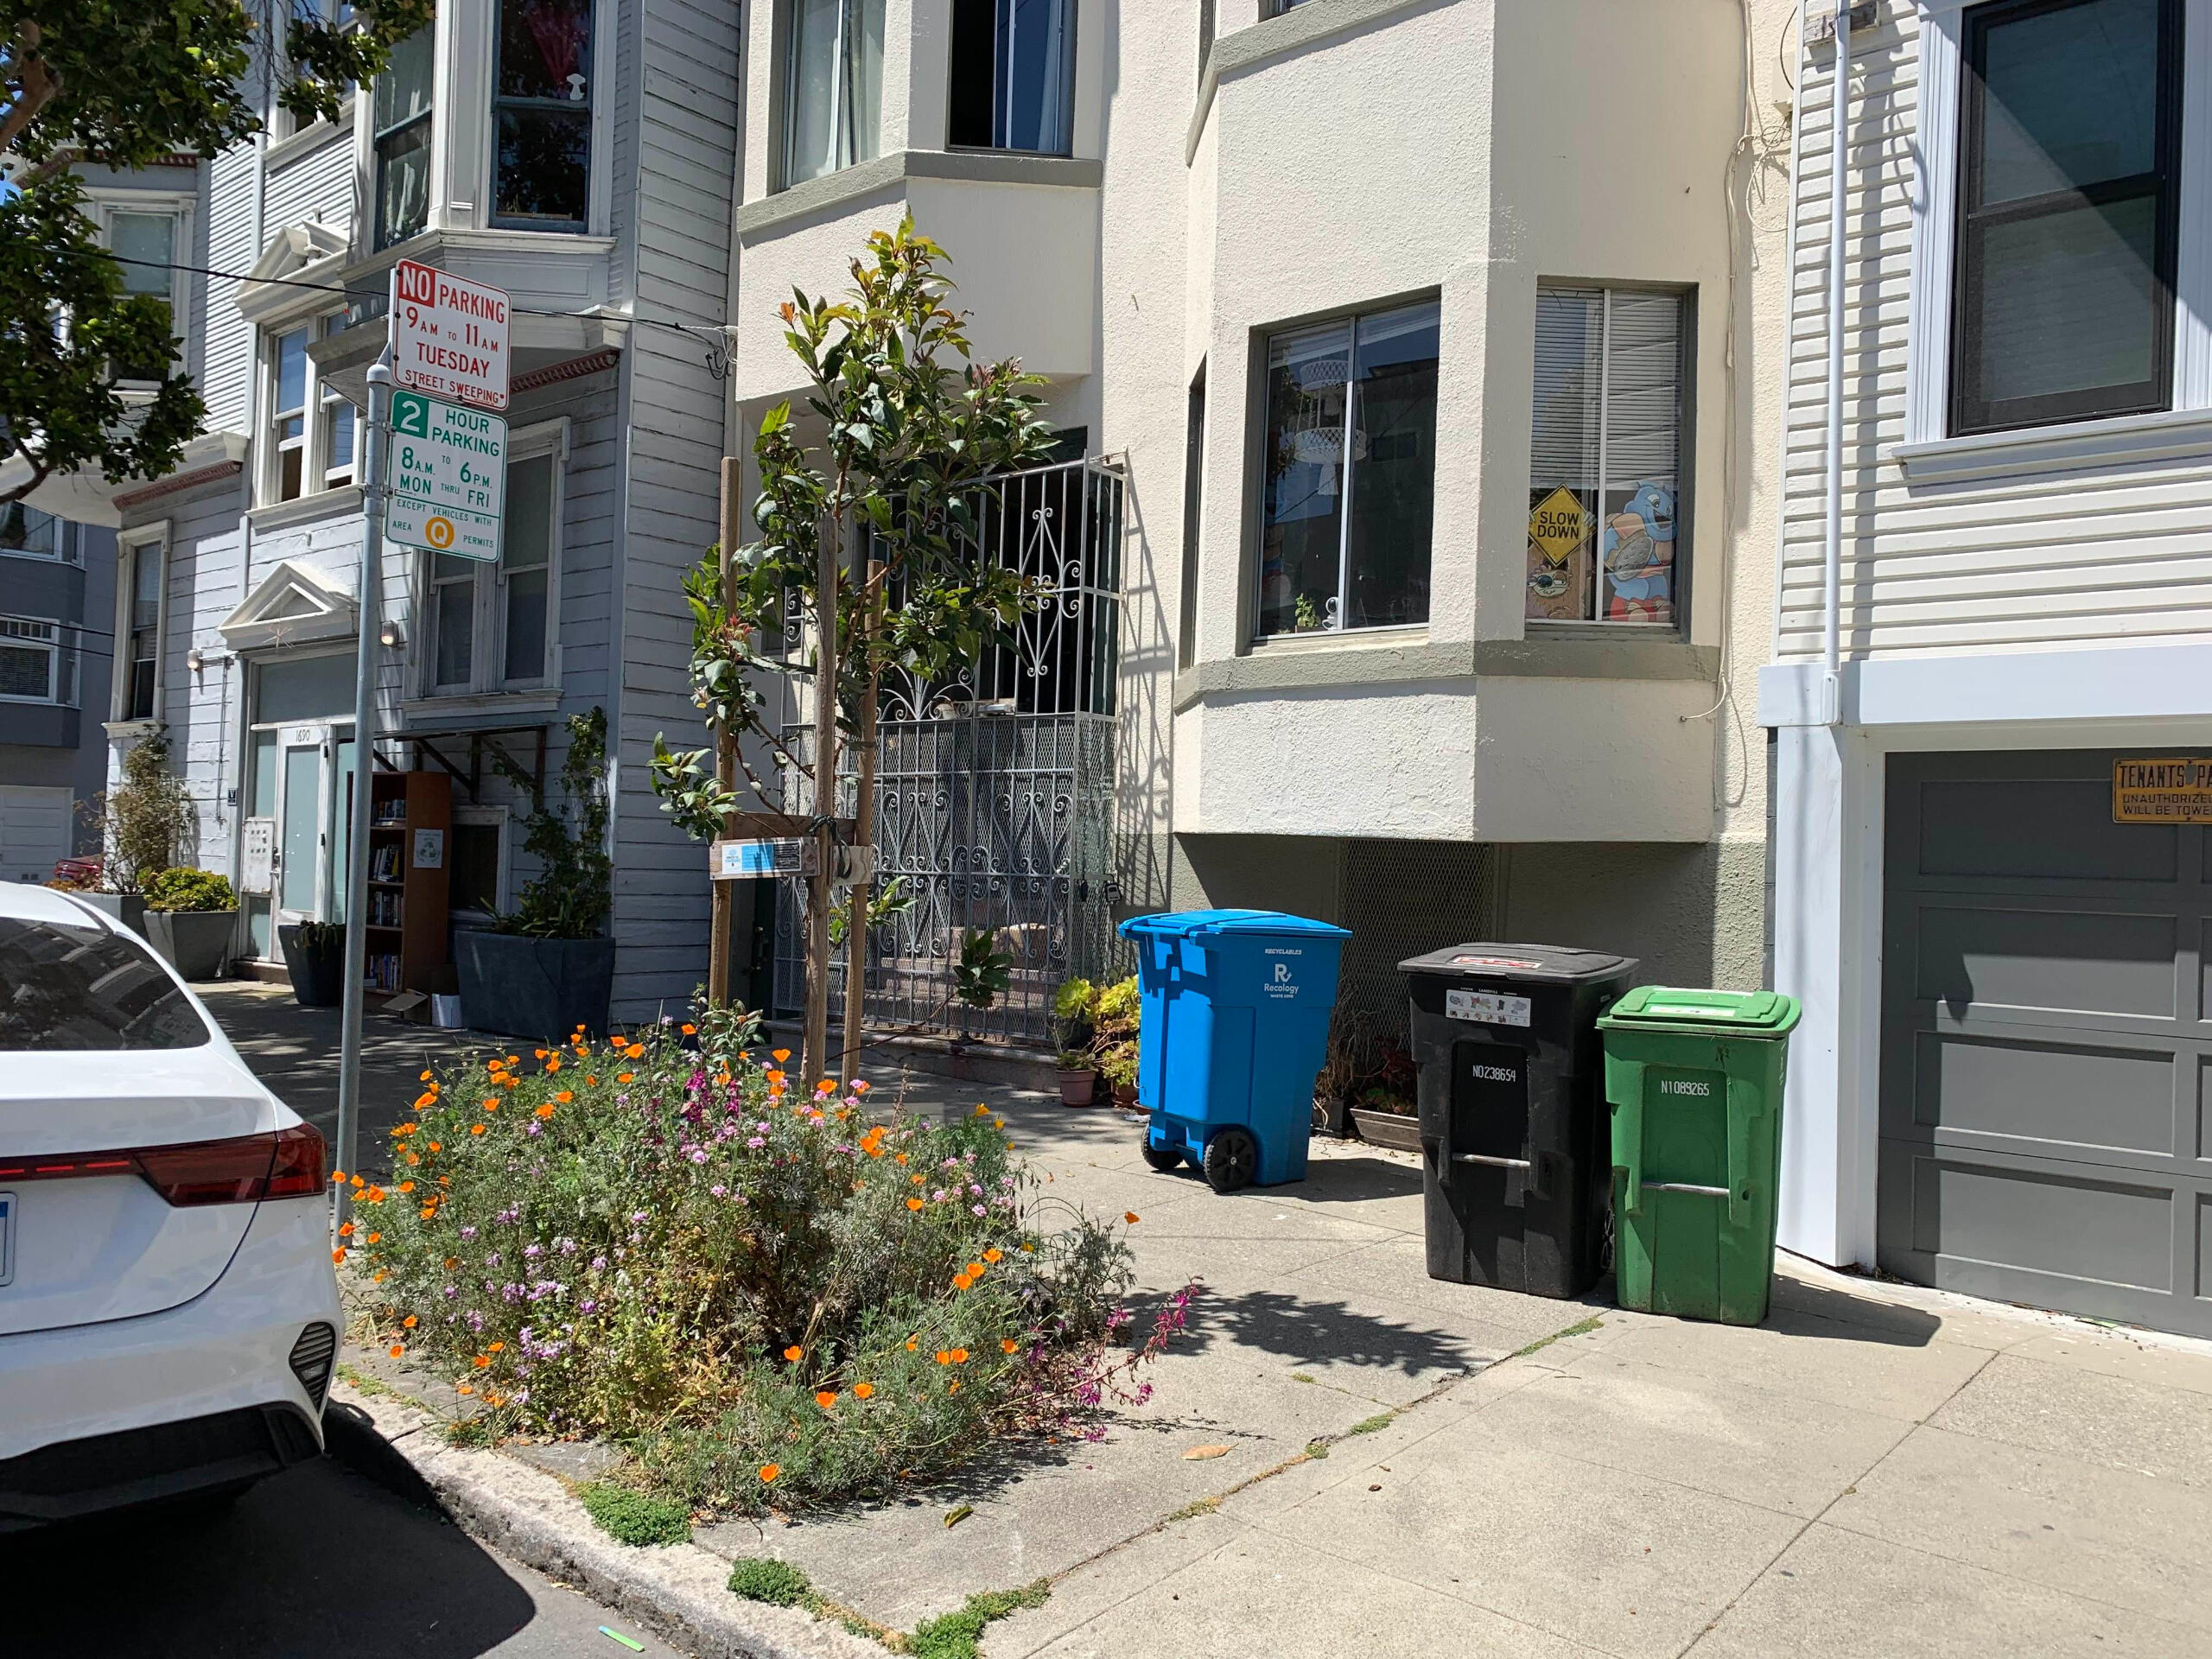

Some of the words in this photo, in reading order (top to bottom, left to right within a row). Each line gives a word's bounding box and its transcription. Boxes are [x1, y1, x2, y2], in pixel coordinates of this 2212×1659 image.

[402, 265, 431, 302] NO
[439, 283, 505, 324] PARKING
[448, 331, 457, 340] TO
[416, 341, 490, 378] TUESDAY
[405, 369, 445, 389] STREET
[449, 380, 499, 404] SWEEPING
[400, 400, 421, 432] 2
[446, 409, 489, 434] HOUR
[432, 426, 499, 457] PARKING
[442, 454, 451, 465] TO
[400, 474, 431, 495] MON
[441, 483, 460, 495] THRU
[467, 489, 490, 508] FRI
[397, 499, 427, 512] EXCEPT
[432, 506, 469, 522] VEHICLES
[474, 515, 492, 526] WITH
[1540, 511, 1580, 526] SLOW
[392, 520, 412, 531] AREA
[430, 521, 449, 545] Q
[463, 534, 494, 549] PERMITS
[1537, 524, 1580, 540] DOWN
[296, 729, 310, 742] 1690
[2120, 765, 2184, 788] TENANTS
[2123, 805, 2151, 816] WILL
[2156, 805, 2171, 816] BE
[2177, 805, 2212, 816] TOWE
[1264, 983, 1300, 994] Recology
[1661, 1079, 1710, 1096] N1089265
